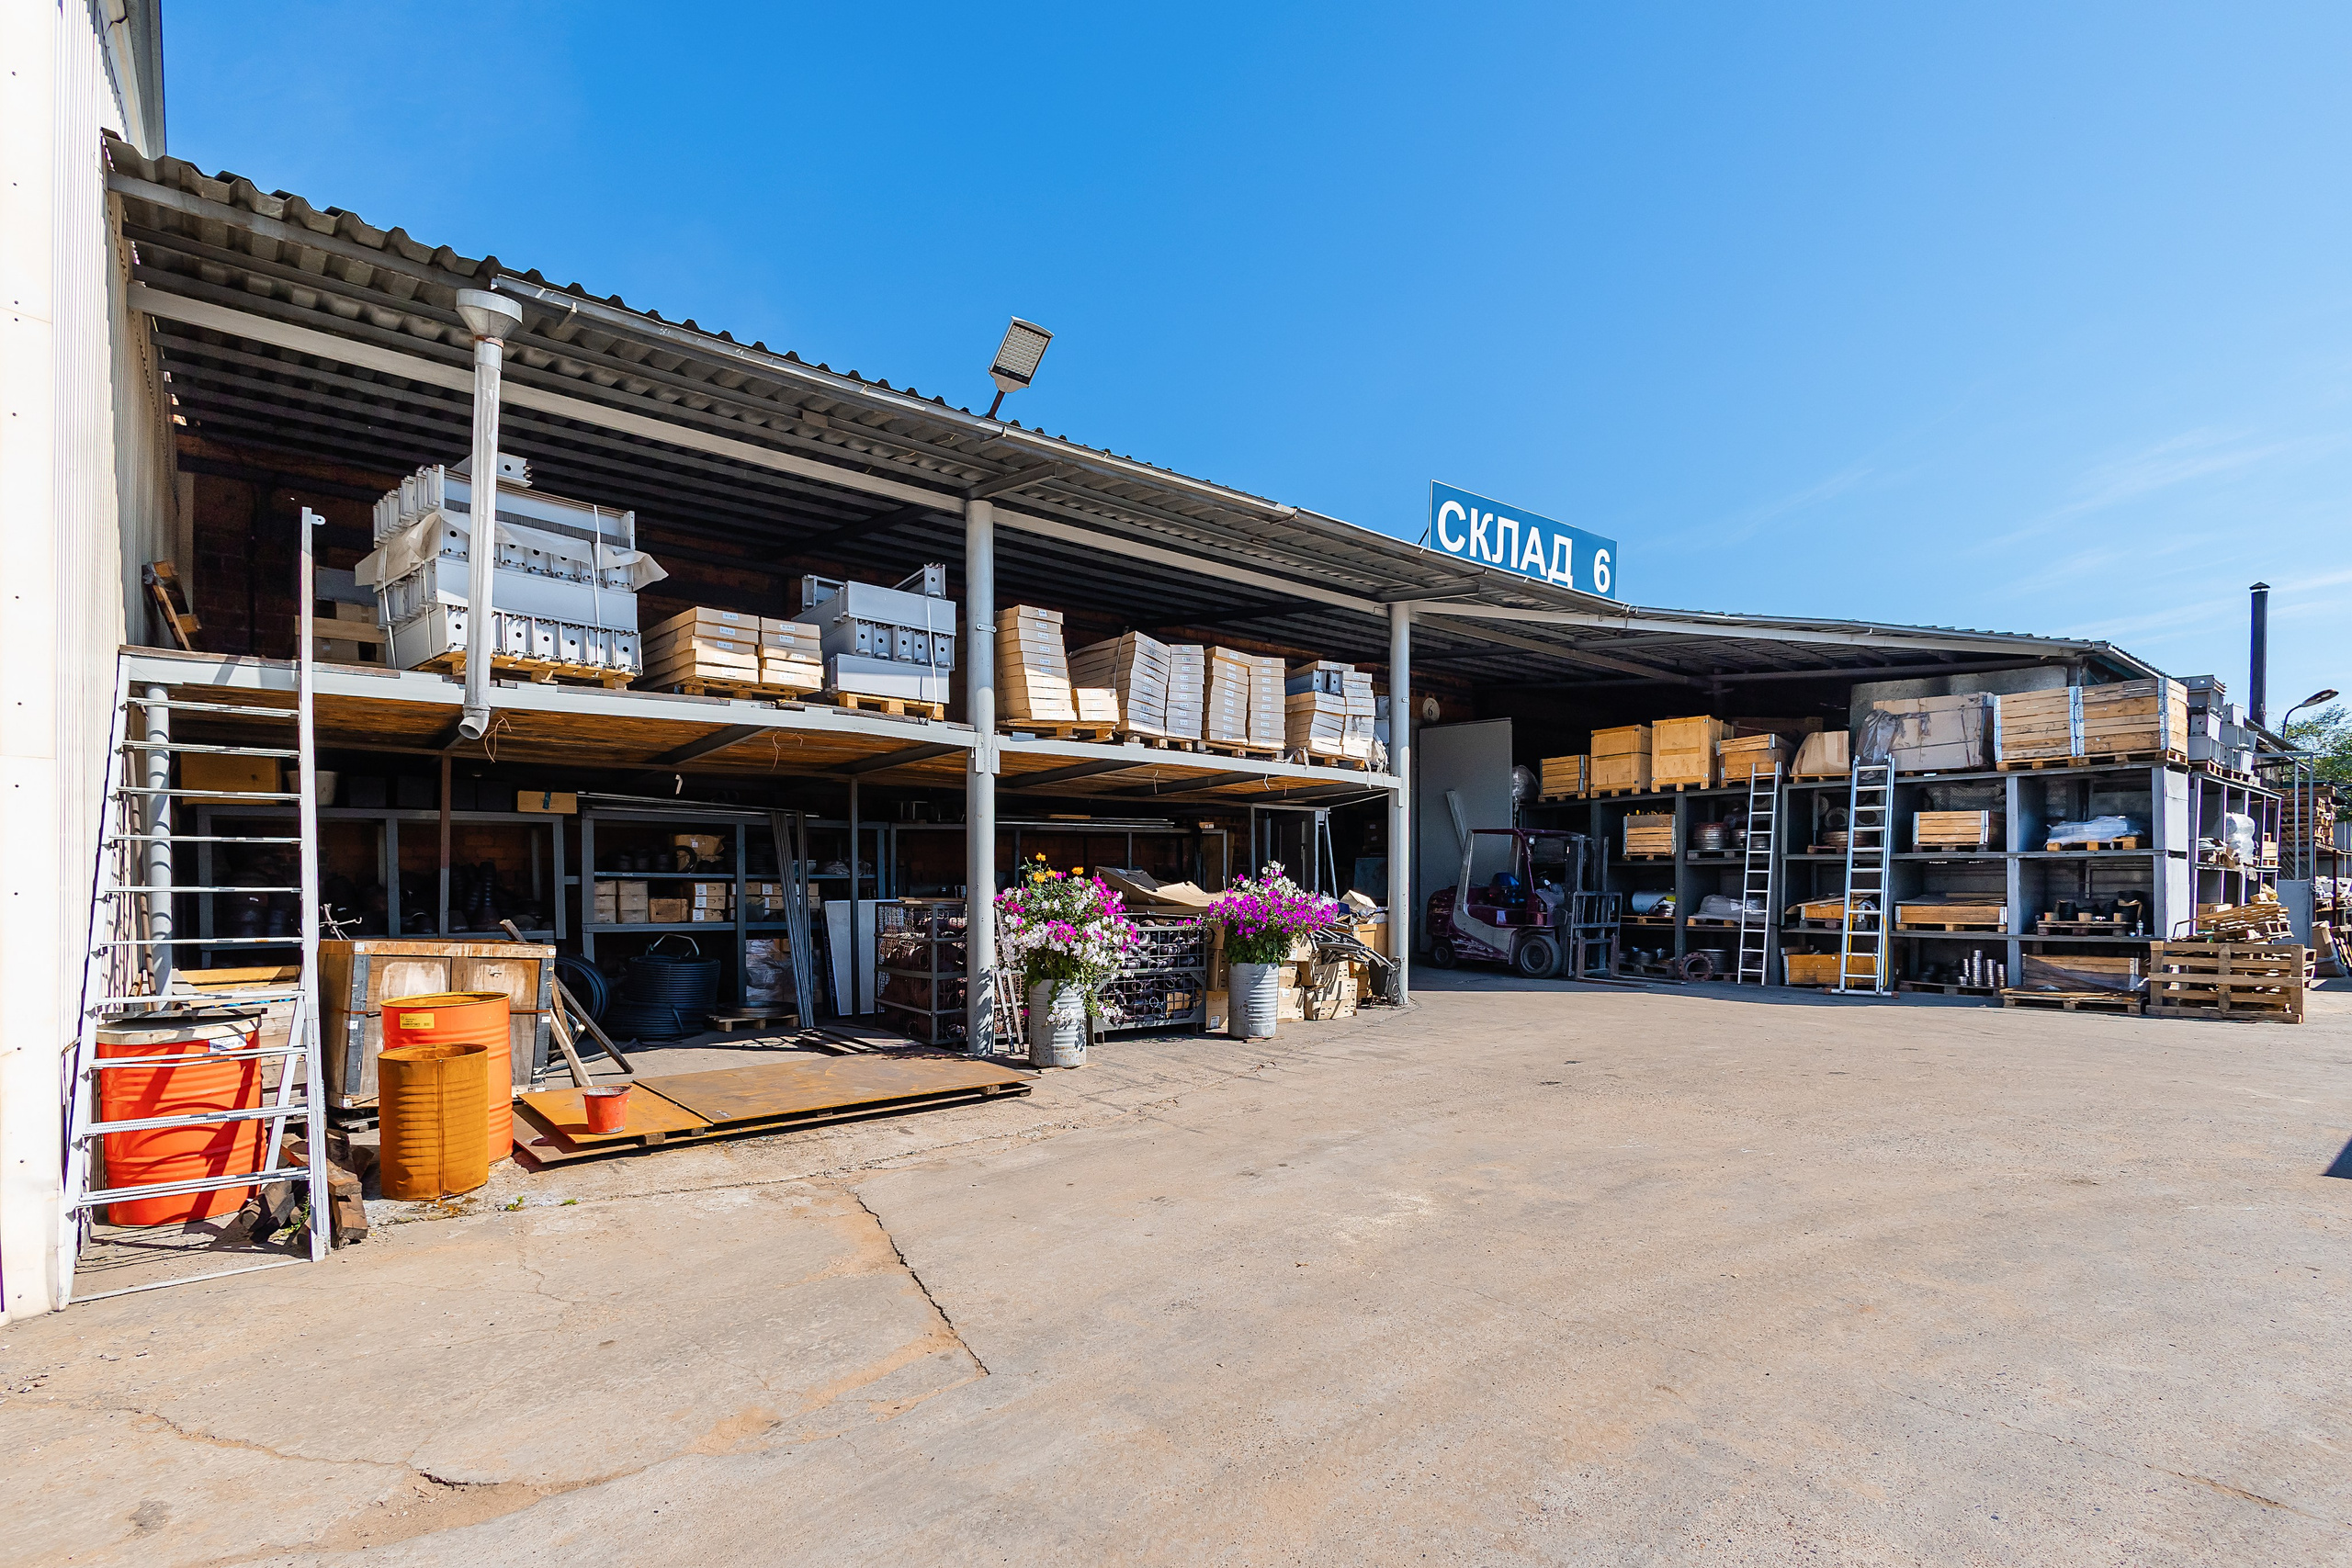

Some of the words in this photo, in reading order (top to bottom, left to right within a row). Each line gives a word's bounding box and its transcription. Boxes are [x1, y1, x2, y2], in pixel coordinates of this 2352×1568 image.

[1437, 500, 1574, 589] СКЛАД
[1593, 548, 1611, 593] 6
[1428, 705, 1433, 716] 6
